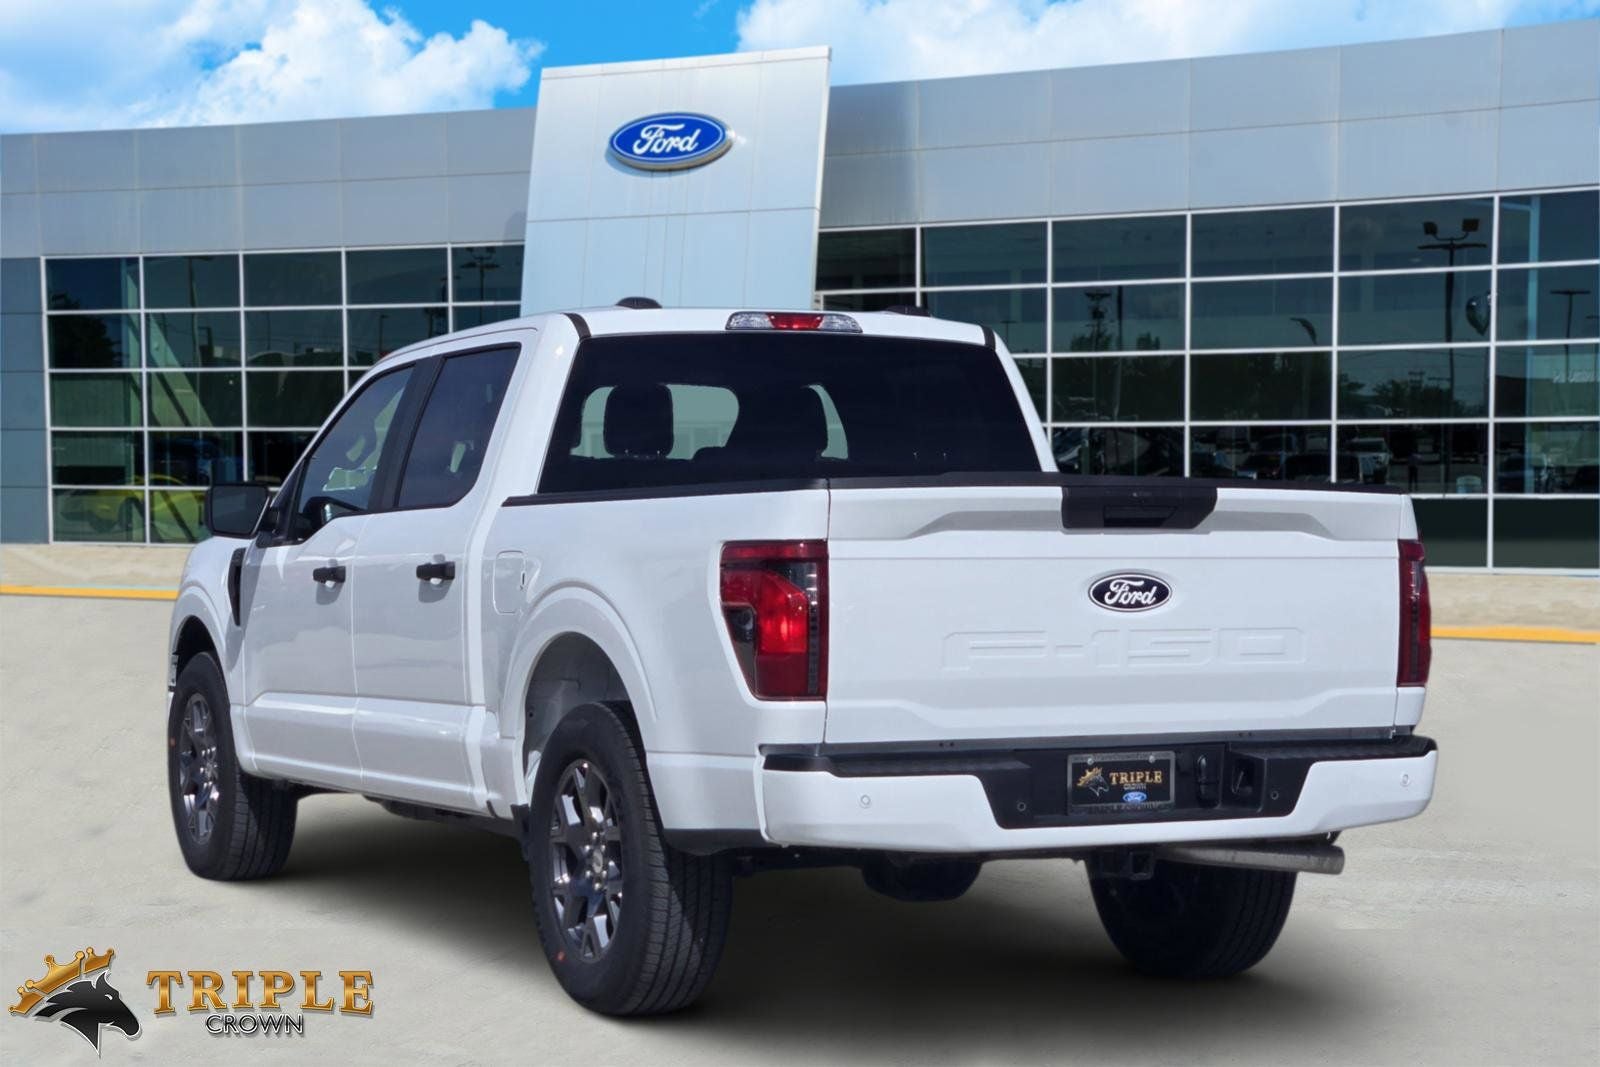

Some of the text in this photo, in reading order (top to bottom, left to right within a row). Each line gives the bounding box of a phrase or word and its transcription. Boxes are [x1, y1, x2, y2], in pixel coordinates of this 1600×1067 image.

[633, 124, 701, 155] Ford
[1104, 579, 1157, 604] Ford
[942, 628, 1305, 671] F-150
[1109, 770, 1162, 785] TRIPLE
